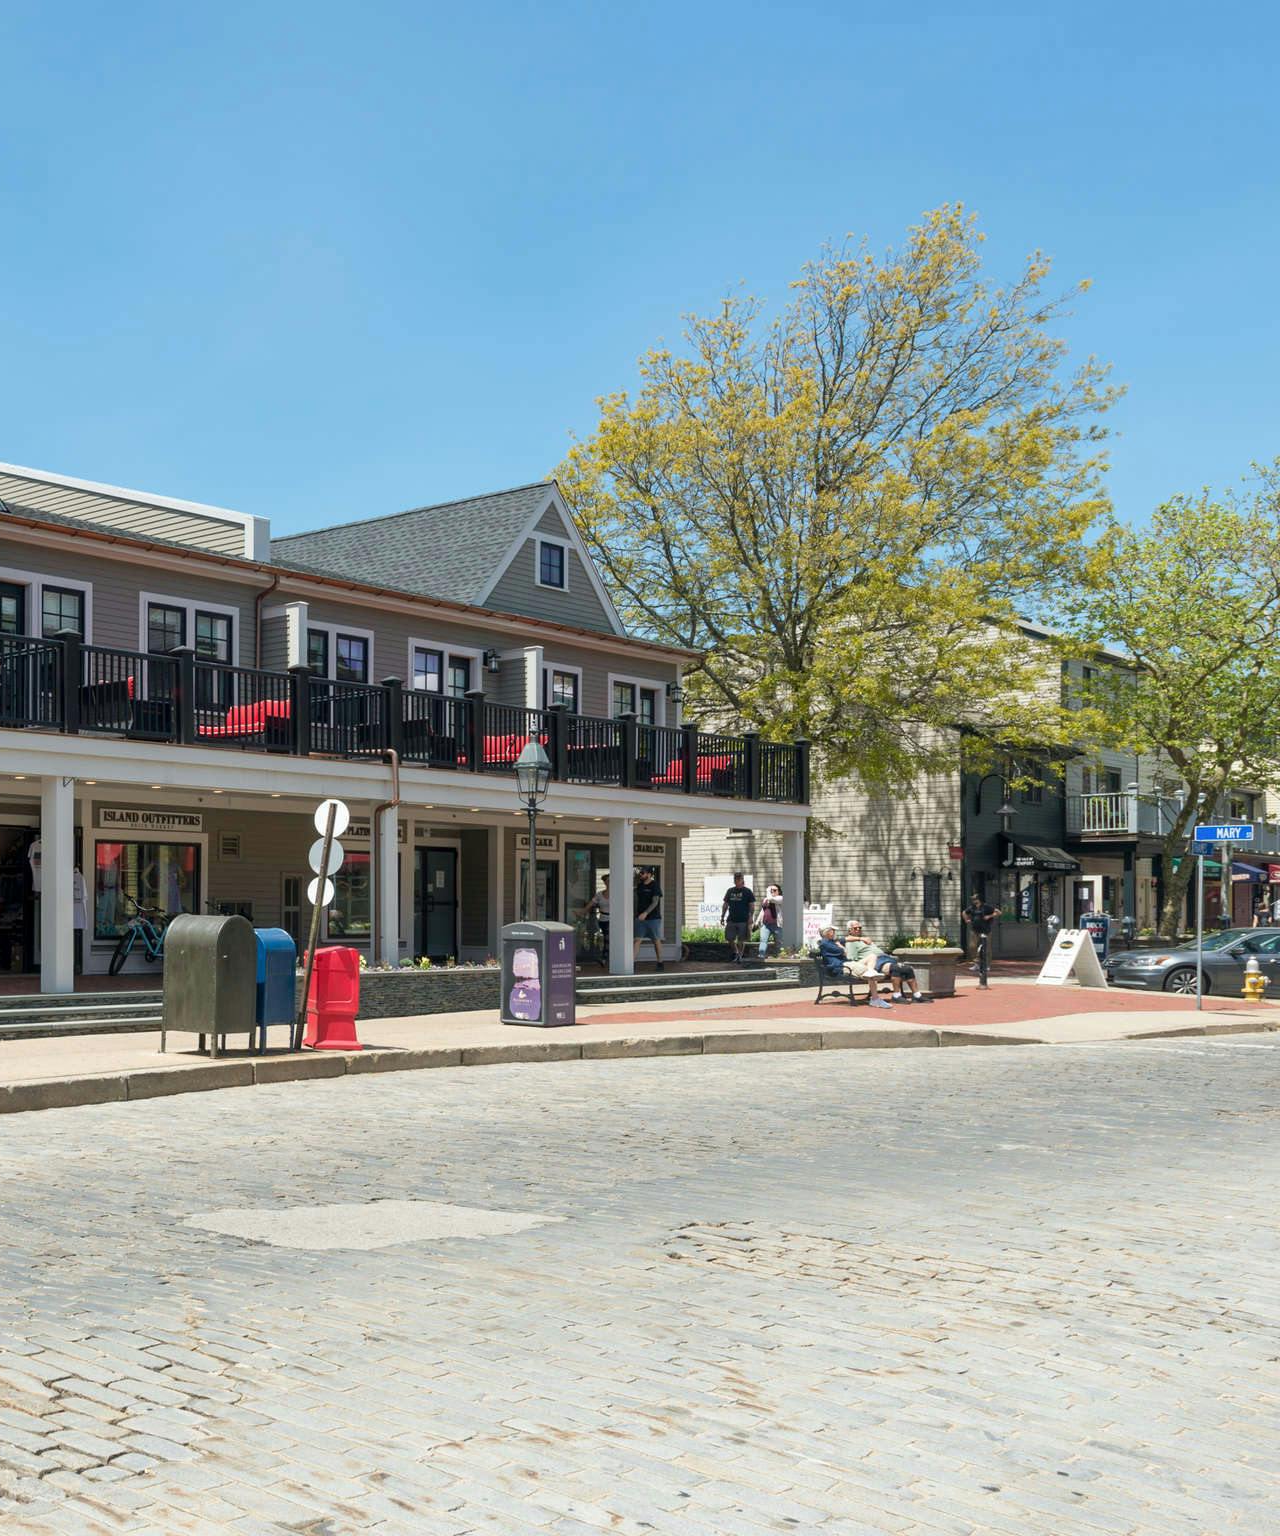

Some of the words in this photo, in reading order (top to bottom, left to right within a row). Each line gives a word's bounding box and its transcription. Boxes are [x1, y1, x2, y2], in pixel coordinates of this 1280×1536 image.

[103, 810, 139, 823] ISLAND
[141, 812, 201, 826] OUTFITTERS
[1216, 827, 1242, 839] MARY
[1021, 890, 1030, 918] OPEN
